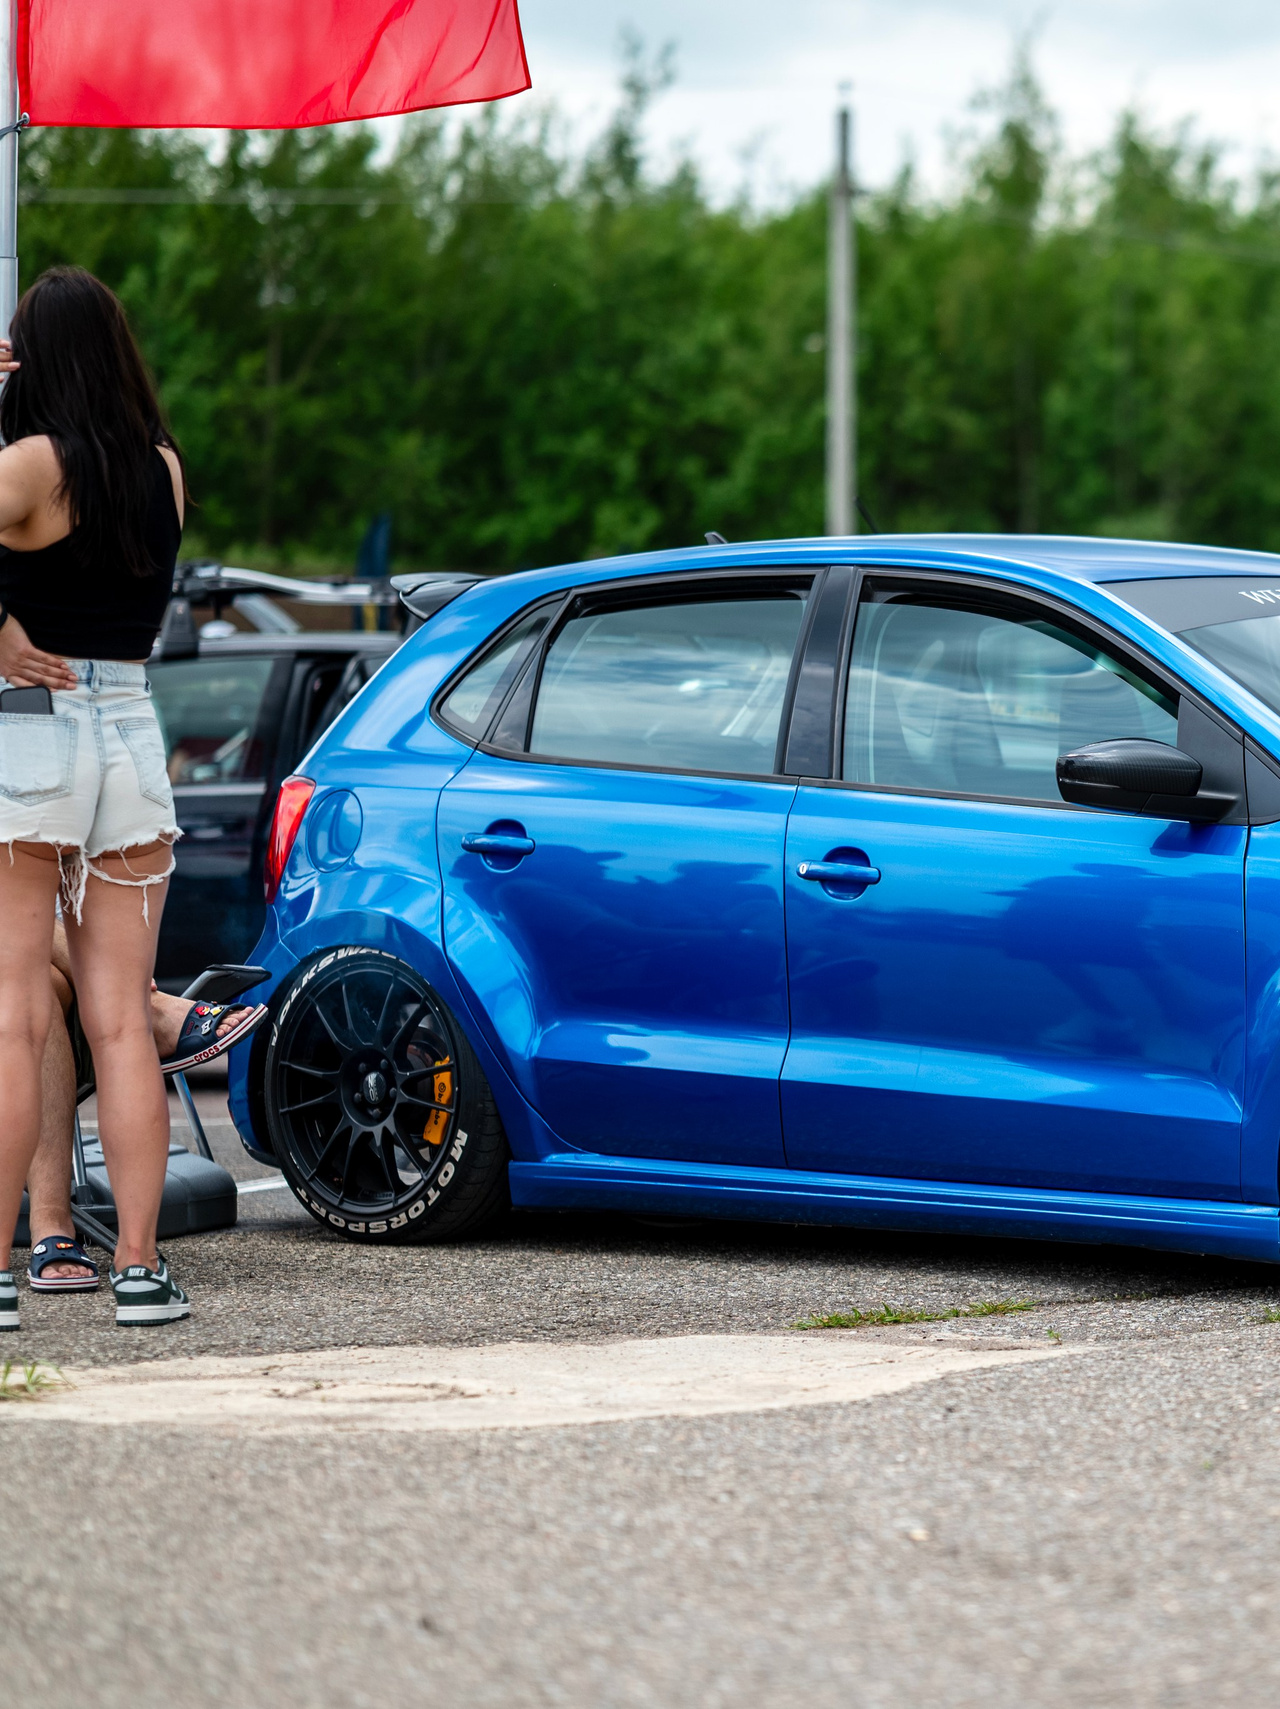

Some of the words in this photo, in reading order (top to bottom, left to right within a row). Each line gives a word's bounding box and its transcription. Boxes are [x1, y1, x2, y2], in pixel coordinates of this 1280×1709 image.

[193, 1045, 220, 1063] crocs
[296, 1128, 468, 1234] MOTORSPORT
[127, 1267, 147, 1277] NIKE
